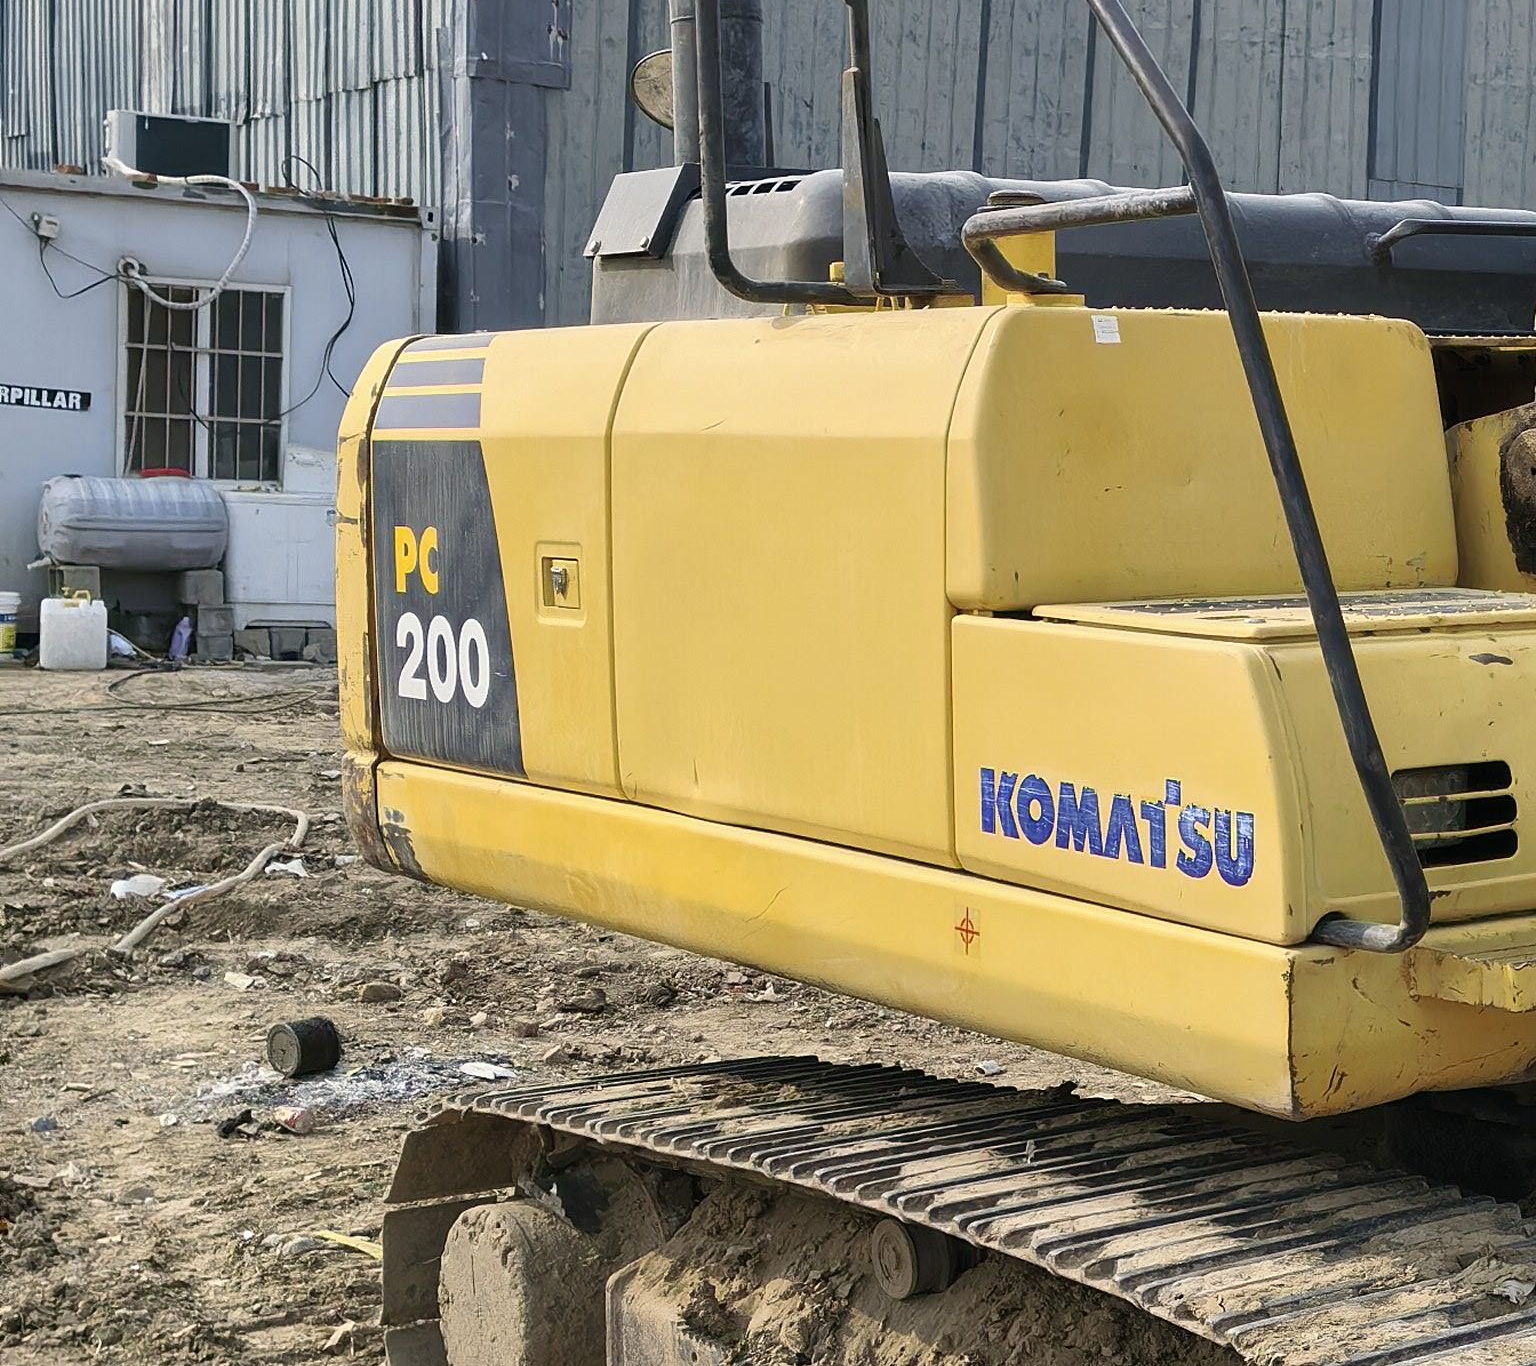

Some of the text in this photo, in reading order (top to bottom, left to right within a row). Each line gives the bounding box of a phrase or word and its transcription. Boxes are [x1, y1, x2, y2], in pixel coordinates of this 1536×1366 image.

[394, 525, 440, 595] PC
[396, 611, 490, 709] 200
[979, 766, 1255, 887] KOMATSU
